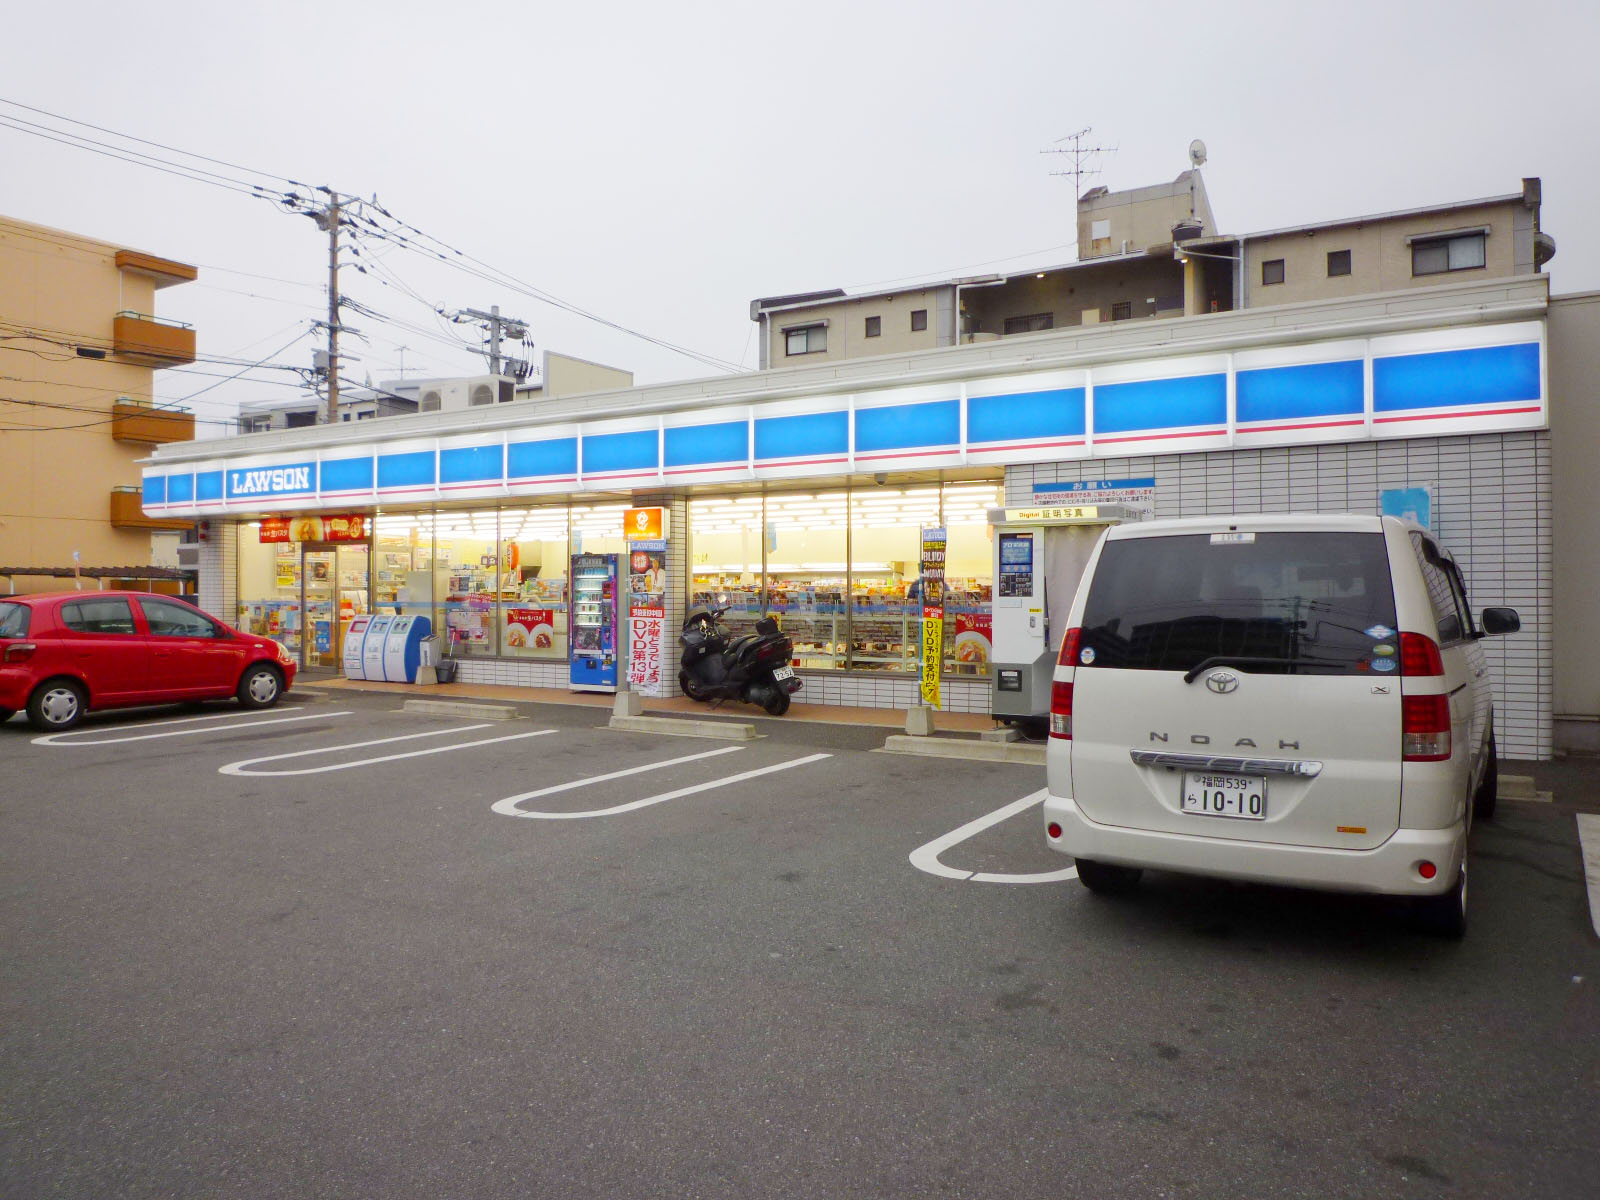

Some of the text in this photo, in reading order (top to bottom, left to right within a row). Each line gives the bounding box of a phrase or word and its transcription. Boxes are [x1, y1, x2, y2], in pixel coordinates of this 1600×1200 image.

[232, 467, 309, 494] LAWSON
[1073, 481, 1112, 490] お願い
[1042, 508, 1084, 519] 証明写真
[631, 541, 665, 550] LAWSON
[630, 619, 647, 684] DVD第13弾
[647, 620, 661, 684] 水曜どうでしょう
[1150, 732, 1300, 750] NOAH
[1187, 789, 1261, 815] ら 10-10
